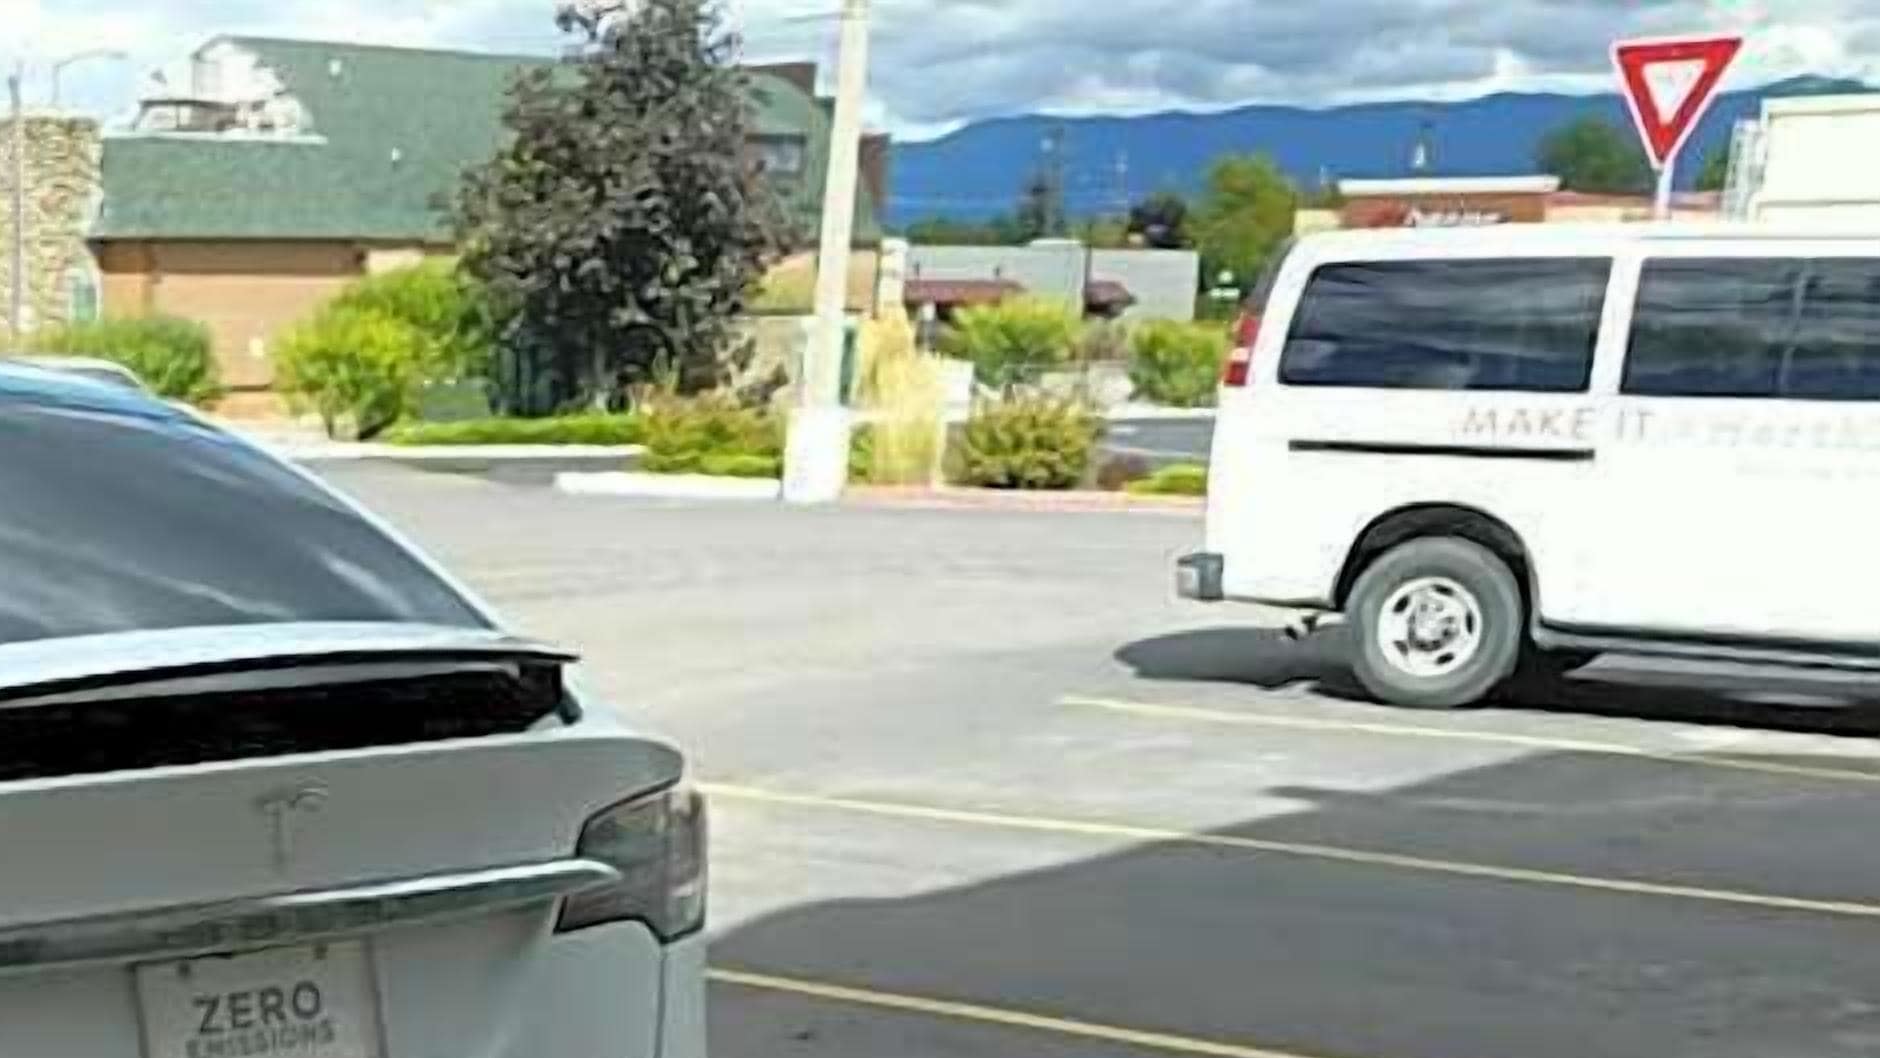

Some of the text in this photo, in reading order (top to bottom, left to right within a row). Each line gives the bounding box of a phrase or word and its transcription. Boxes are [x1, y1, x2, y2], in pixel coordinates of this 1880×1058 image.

[1461, 405, 1596, 441] MAKE
[1614, 409, 1657, 442] IT
[192, 980, 321, 1034] ZERO
